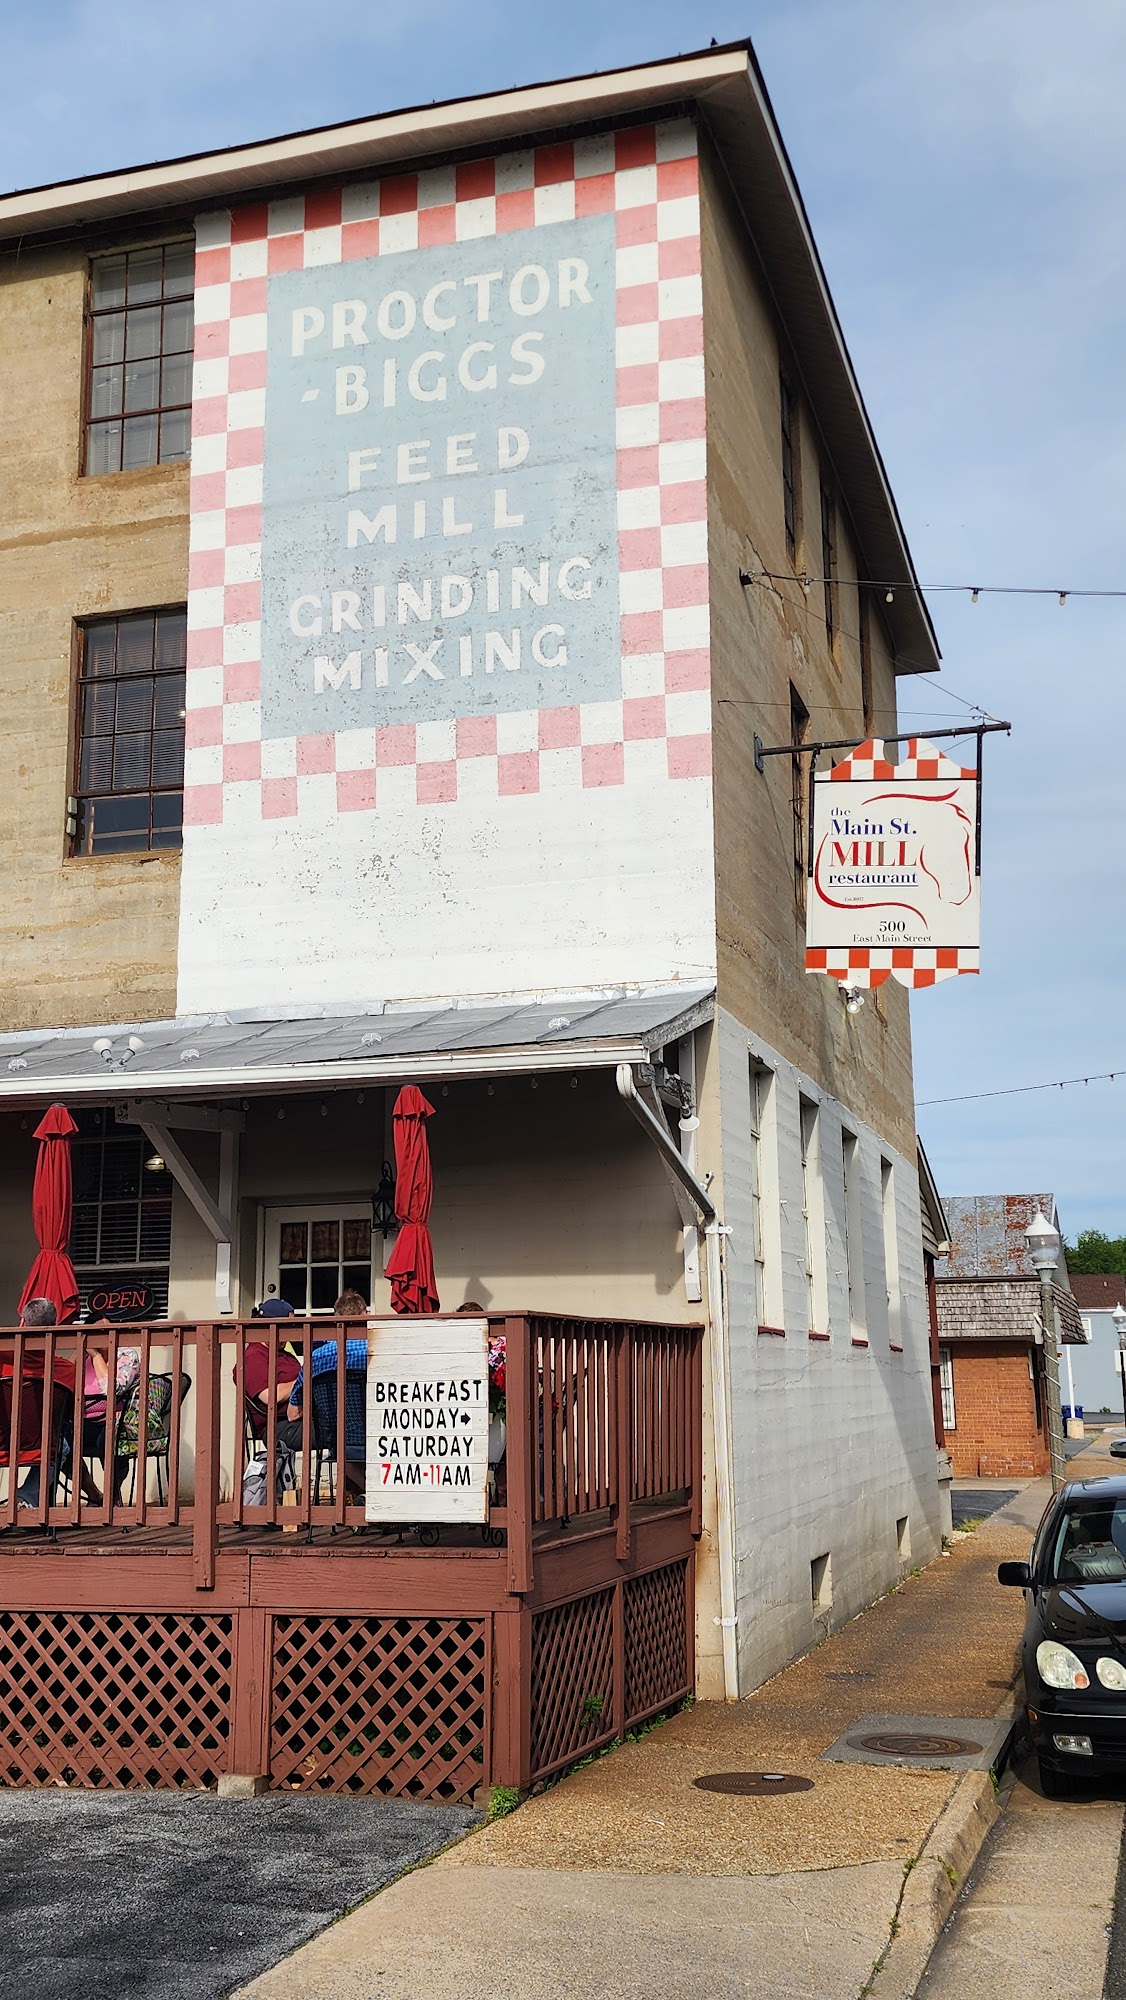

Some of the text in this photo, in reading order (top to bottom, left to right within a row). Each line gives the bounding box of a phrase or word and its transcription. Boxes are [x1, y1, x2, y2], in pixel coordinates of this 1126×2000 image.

[291, 257, 594, 357] PROCTOR
[348, 427, 531, 492] FEED
[346, 489, 524, 548] MILL
[289, 557, 593, 637] GRINDING
[313, 624, 567, 694] MIXING
[831, 807, 851, 816] the
[830, 817, 917, 835] Main St.
[829, 840, 917, 867] MILL
[828, 873, 918, 884] restaurant
[879, 920, 906, 932] 500
[853, 934, 932, 943] East Main Street
[92, 1290, 147, 1310] OPEN
[375, 1380, 482, 1402] BREAKFAST
[382, 1408, 459, 1430] MONDAY
[378, 1436, 473, 1457] SATURDAY
[381, 1463, 471, 1486] 7AM-11AM
